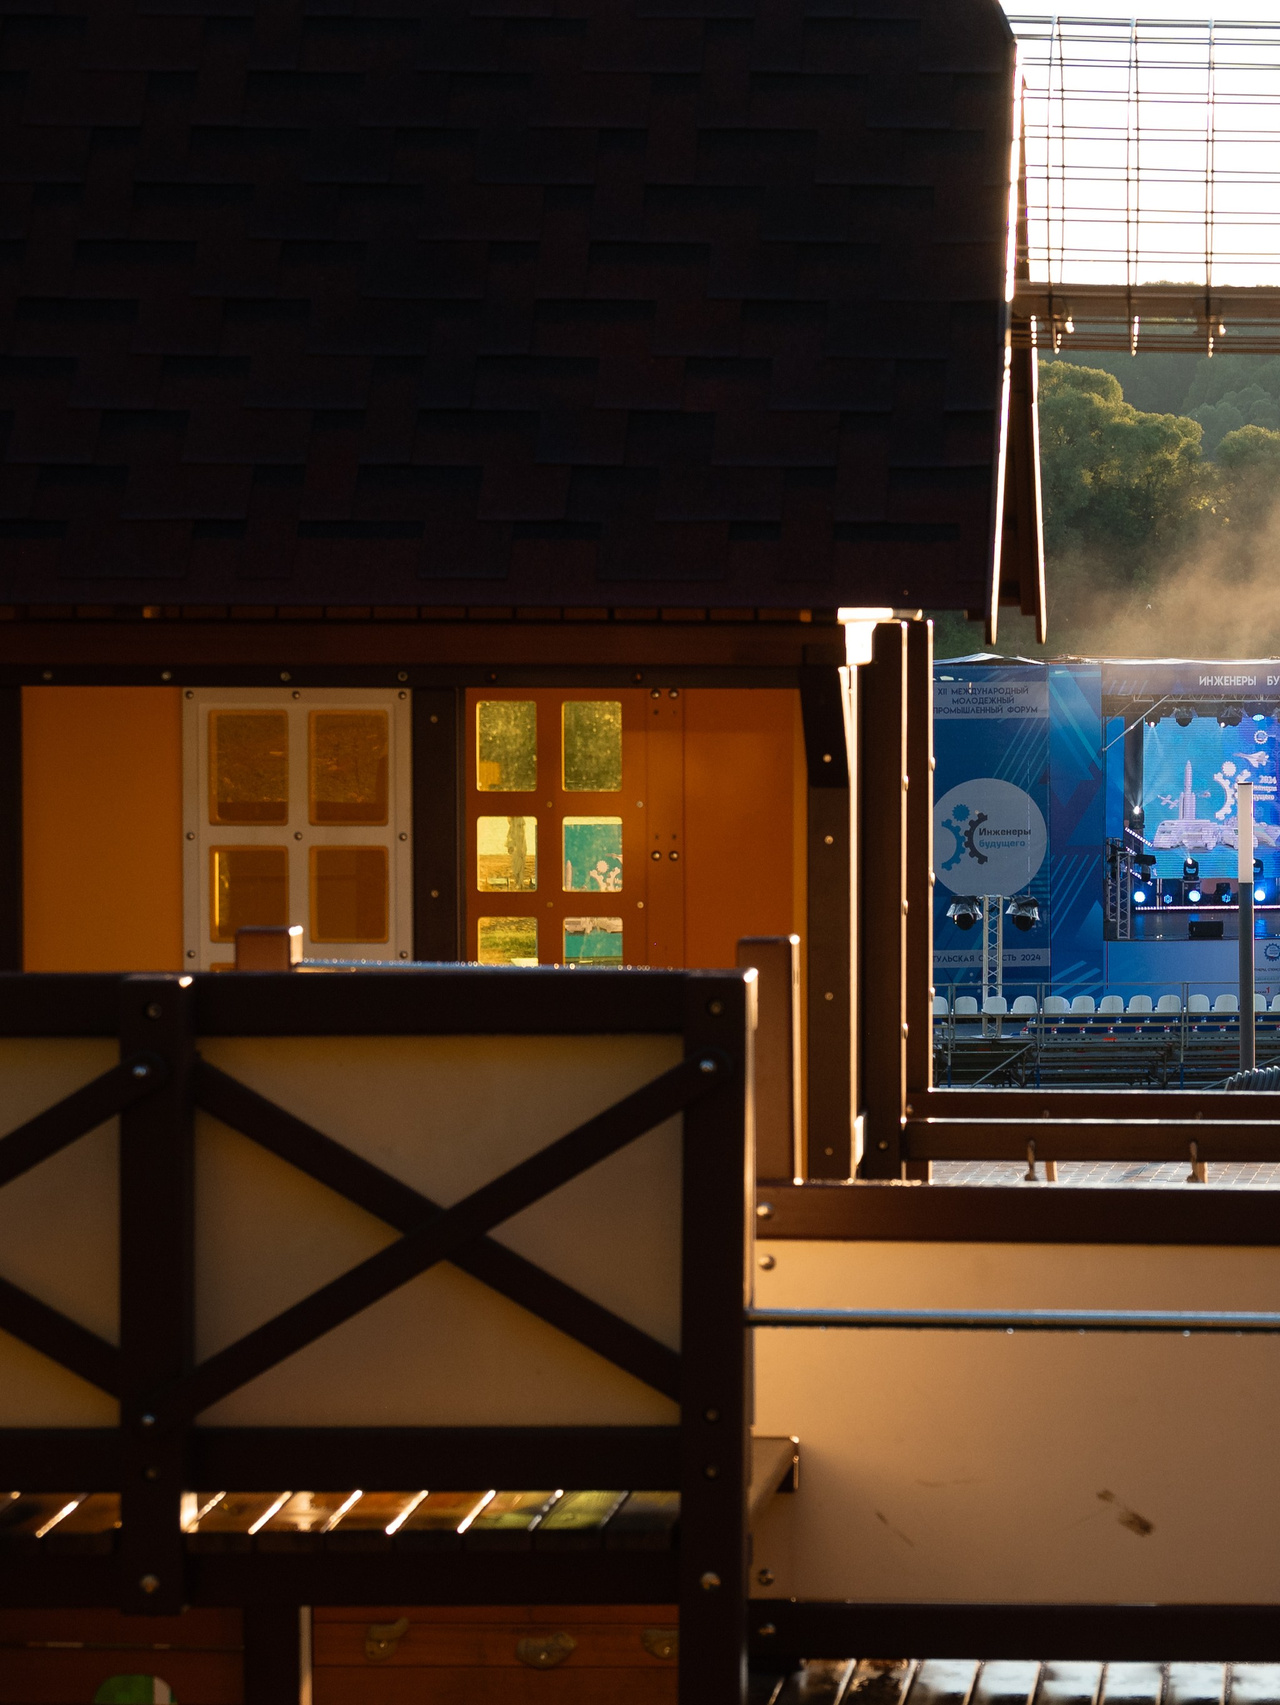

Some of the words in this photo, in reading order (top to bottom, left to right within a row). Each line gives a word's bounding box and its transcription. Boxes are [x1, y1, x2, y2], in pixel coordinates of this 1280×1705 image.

[1199, 675, 1257, 686] ИНЖЕНЕРЫ
[937, 688, 947, 696] XII
[951, 686, 1029, 696] МЕЖДУНАРОДНЫЙ
[952, 696, 1015, 705] МОЛОДЕЖНЫЙ
[1007, 706, 1038, 714] ФОРУМ
[979, 828, 1031, 837] Инженеры
[979, 840, 1026, 849] будущего
[1020, 954, 1042, 962] 2024
